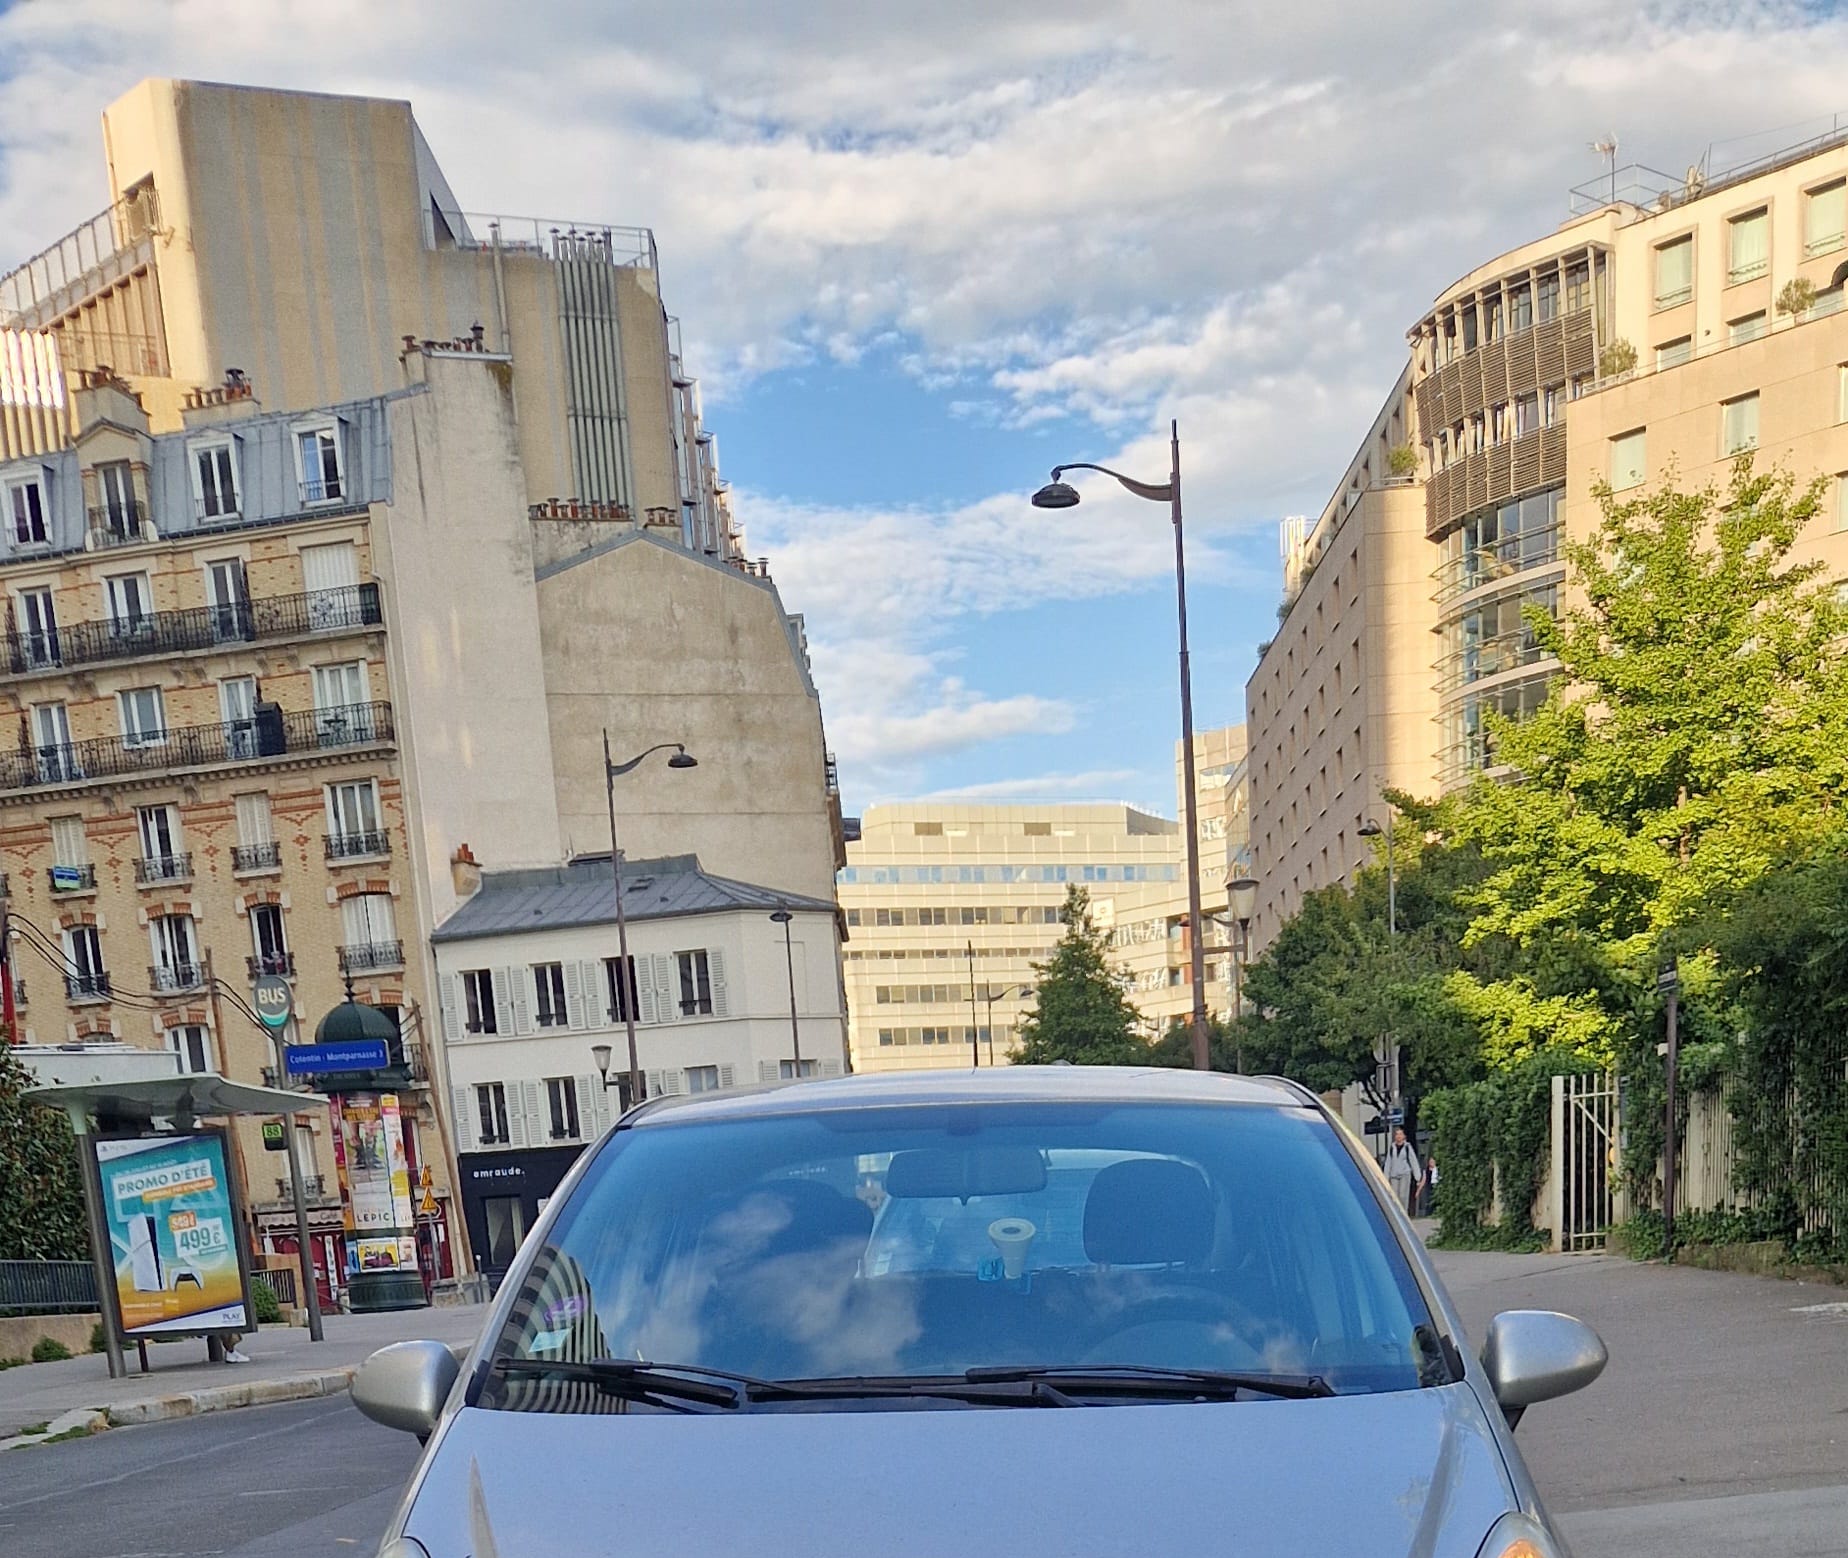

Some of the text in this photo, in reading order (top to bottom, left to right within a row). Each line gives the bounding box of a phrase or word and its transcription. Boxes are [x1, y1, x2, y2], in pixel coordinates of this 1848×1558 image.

[257, 987, 286, 1005] BUS
[289, 1054, 321, 1064] Cotentin
[326, 1050, 377, 1061] Montparnasse
[266, 1126, 280, 1136] 88
[117, 1174, 169, 1194] PROMO
[171, 1165, 208, 1183] D'ÉTÉ
[356, 1212, 390, 1222] LEPIC
[180, 1227, 211, 1250] 499
